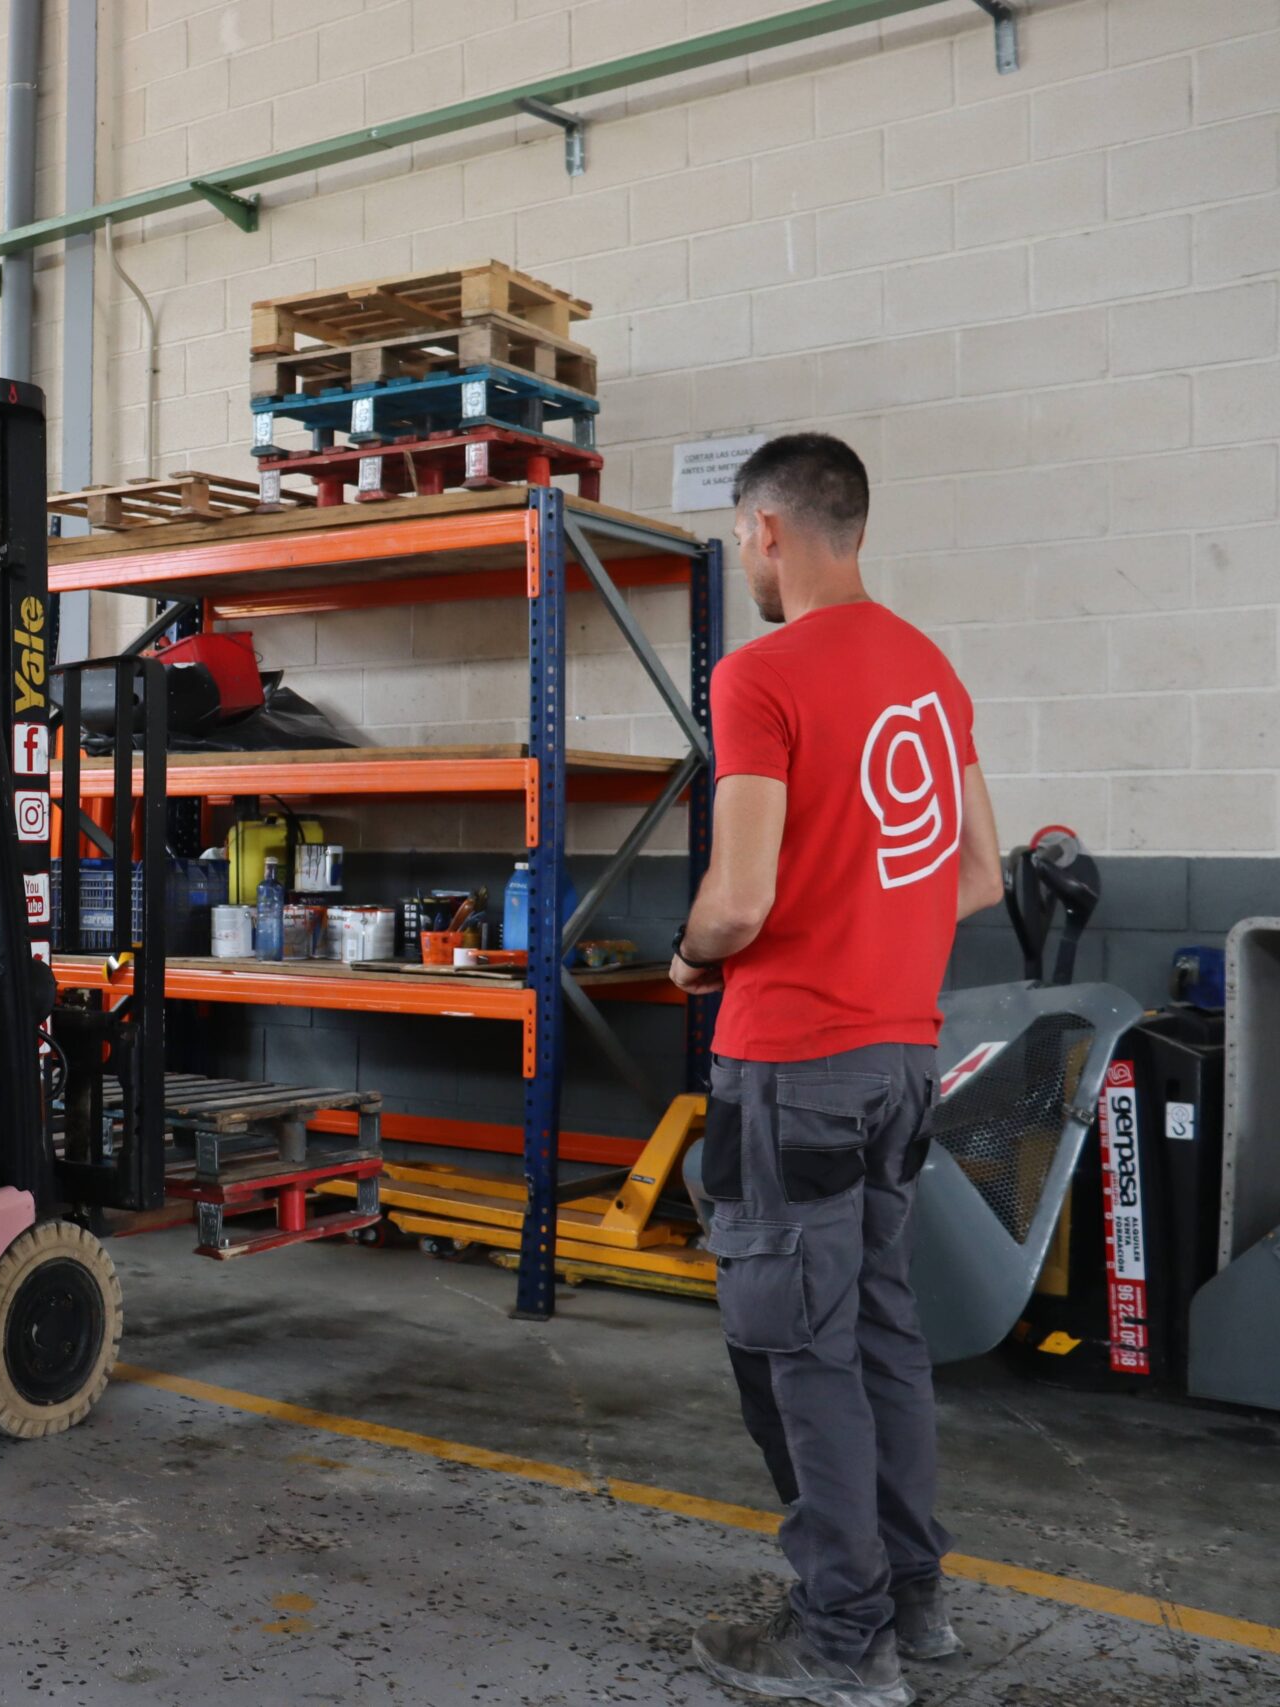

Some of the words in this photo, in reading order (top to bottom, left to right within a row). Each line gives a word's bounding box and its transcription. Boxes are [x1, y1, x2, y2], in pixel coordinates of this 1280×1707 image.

[684, 452, 714, 463] CORTAR
[716, 450, 729, 459] LAS
[681, 466, 705, 475] ANTES
[706, 464, 716, 473] DE
[702, 478, 712, 486] LA
[15, 596, 45, 712] Yale
[25, 879, 39, 895] You
[1111, 1095, 1138, 1207] gerpasa
[1123, 1216, 1132, 1246] VENTA
[1131, 1216, 1140, 1262] ALQUILER
[1117, 1284, 1135, 1301] 96
